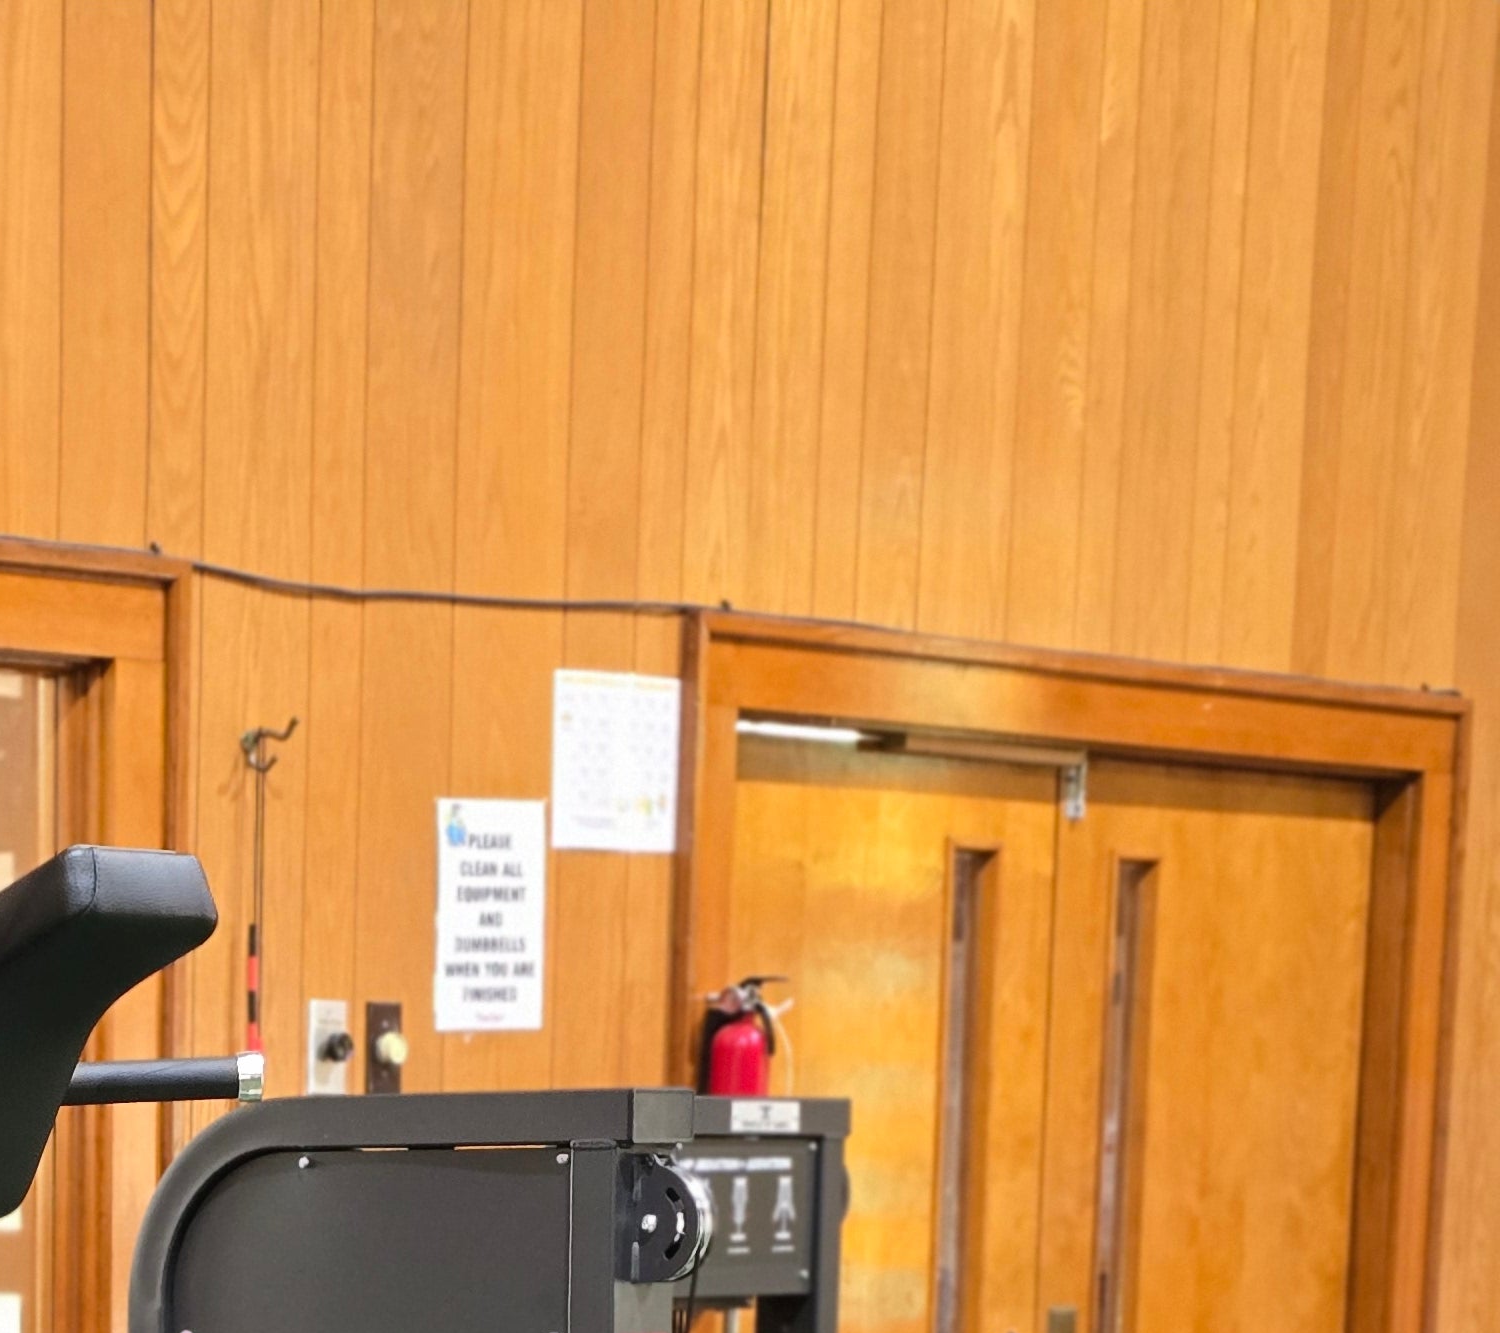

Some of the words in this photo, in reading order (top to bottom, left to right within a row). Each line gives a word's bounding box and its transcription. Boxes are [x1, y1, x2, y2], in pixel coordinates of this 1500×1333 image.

[468, 832, 511, 850] PLEASE
[460, 861, 498, 877] CLEAN
[502, 862, 523, 877] ALL
[457, 886, 526, 902] EQUIPMENT
[479, 911, 503, 928] AND
[455, 936, 526, 953] DUMBBELLS
[445, 962, 480, 978] WHEN
[485, 962, 508, 977] YOU
[513, 962, 535, 977] ARE
[463, 986, 518, 1002] FINISHED
